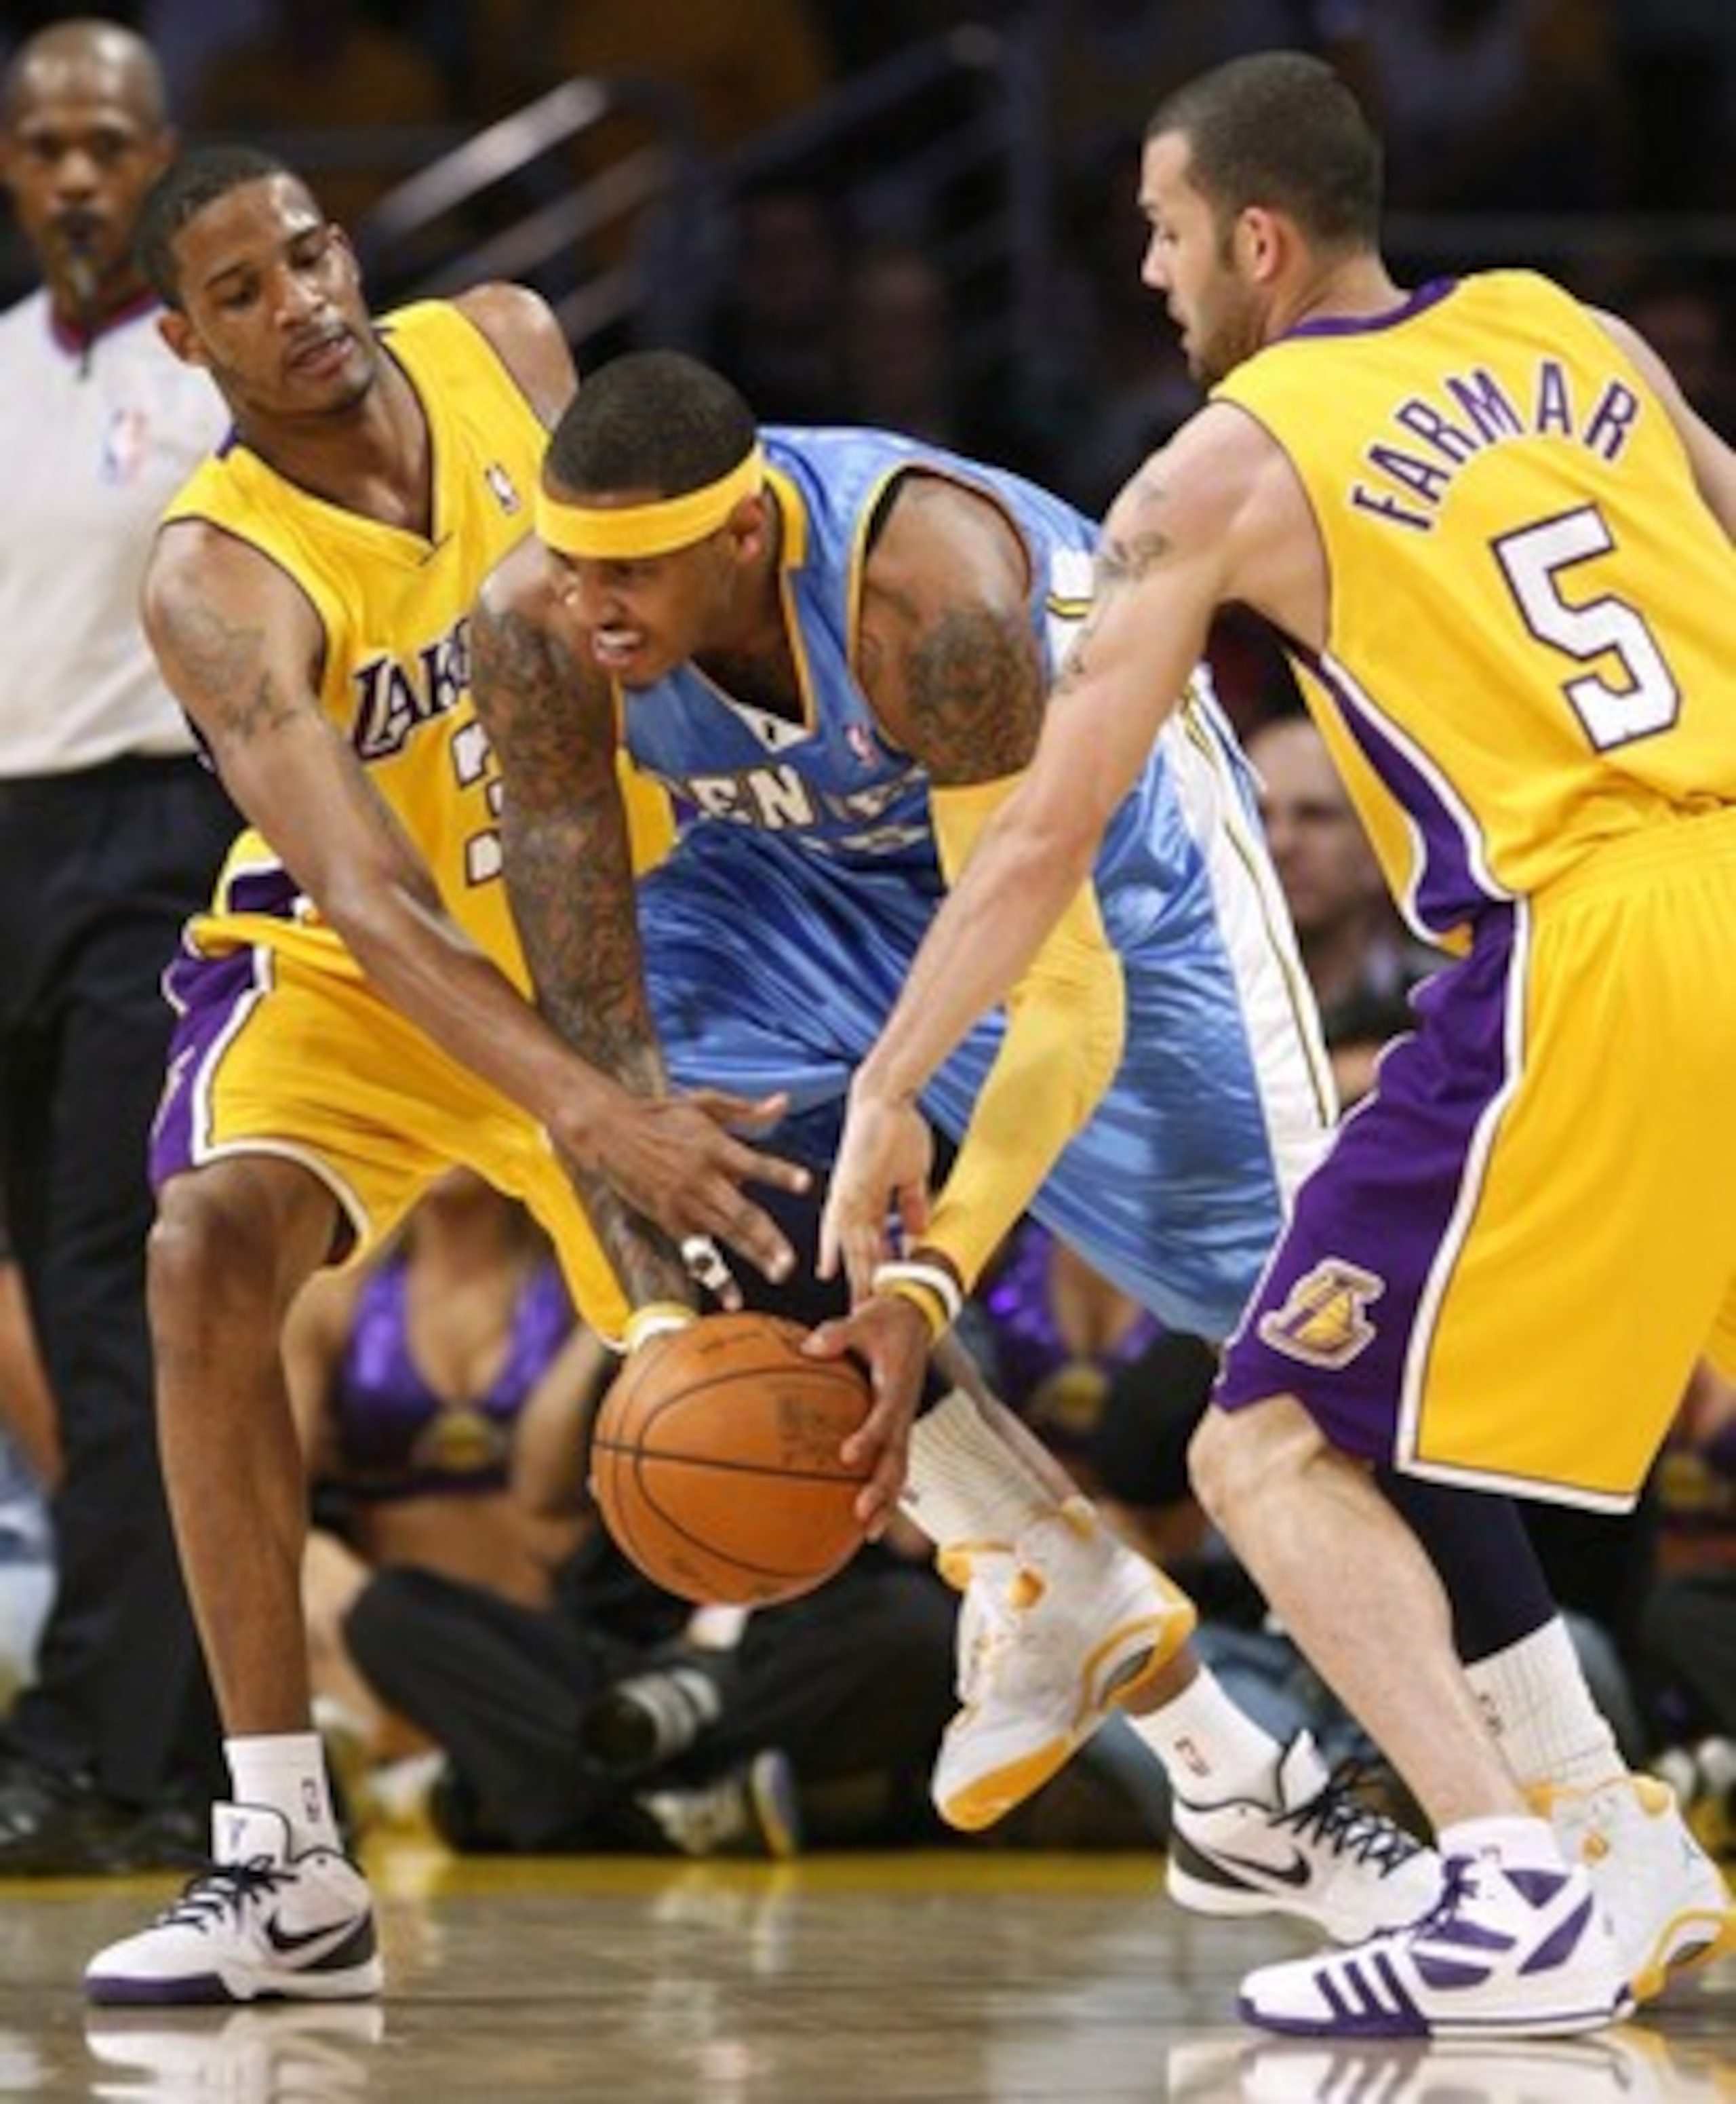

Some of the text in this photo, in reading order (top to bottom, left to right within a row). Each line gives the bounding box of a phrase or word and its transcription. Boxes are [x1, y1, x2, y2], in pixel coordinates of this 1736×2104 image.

[1350, 359, 1641, 532] FARMAR
[352, 616, 473, 762] LAK
[1488, 501, 1682, 755] 5
